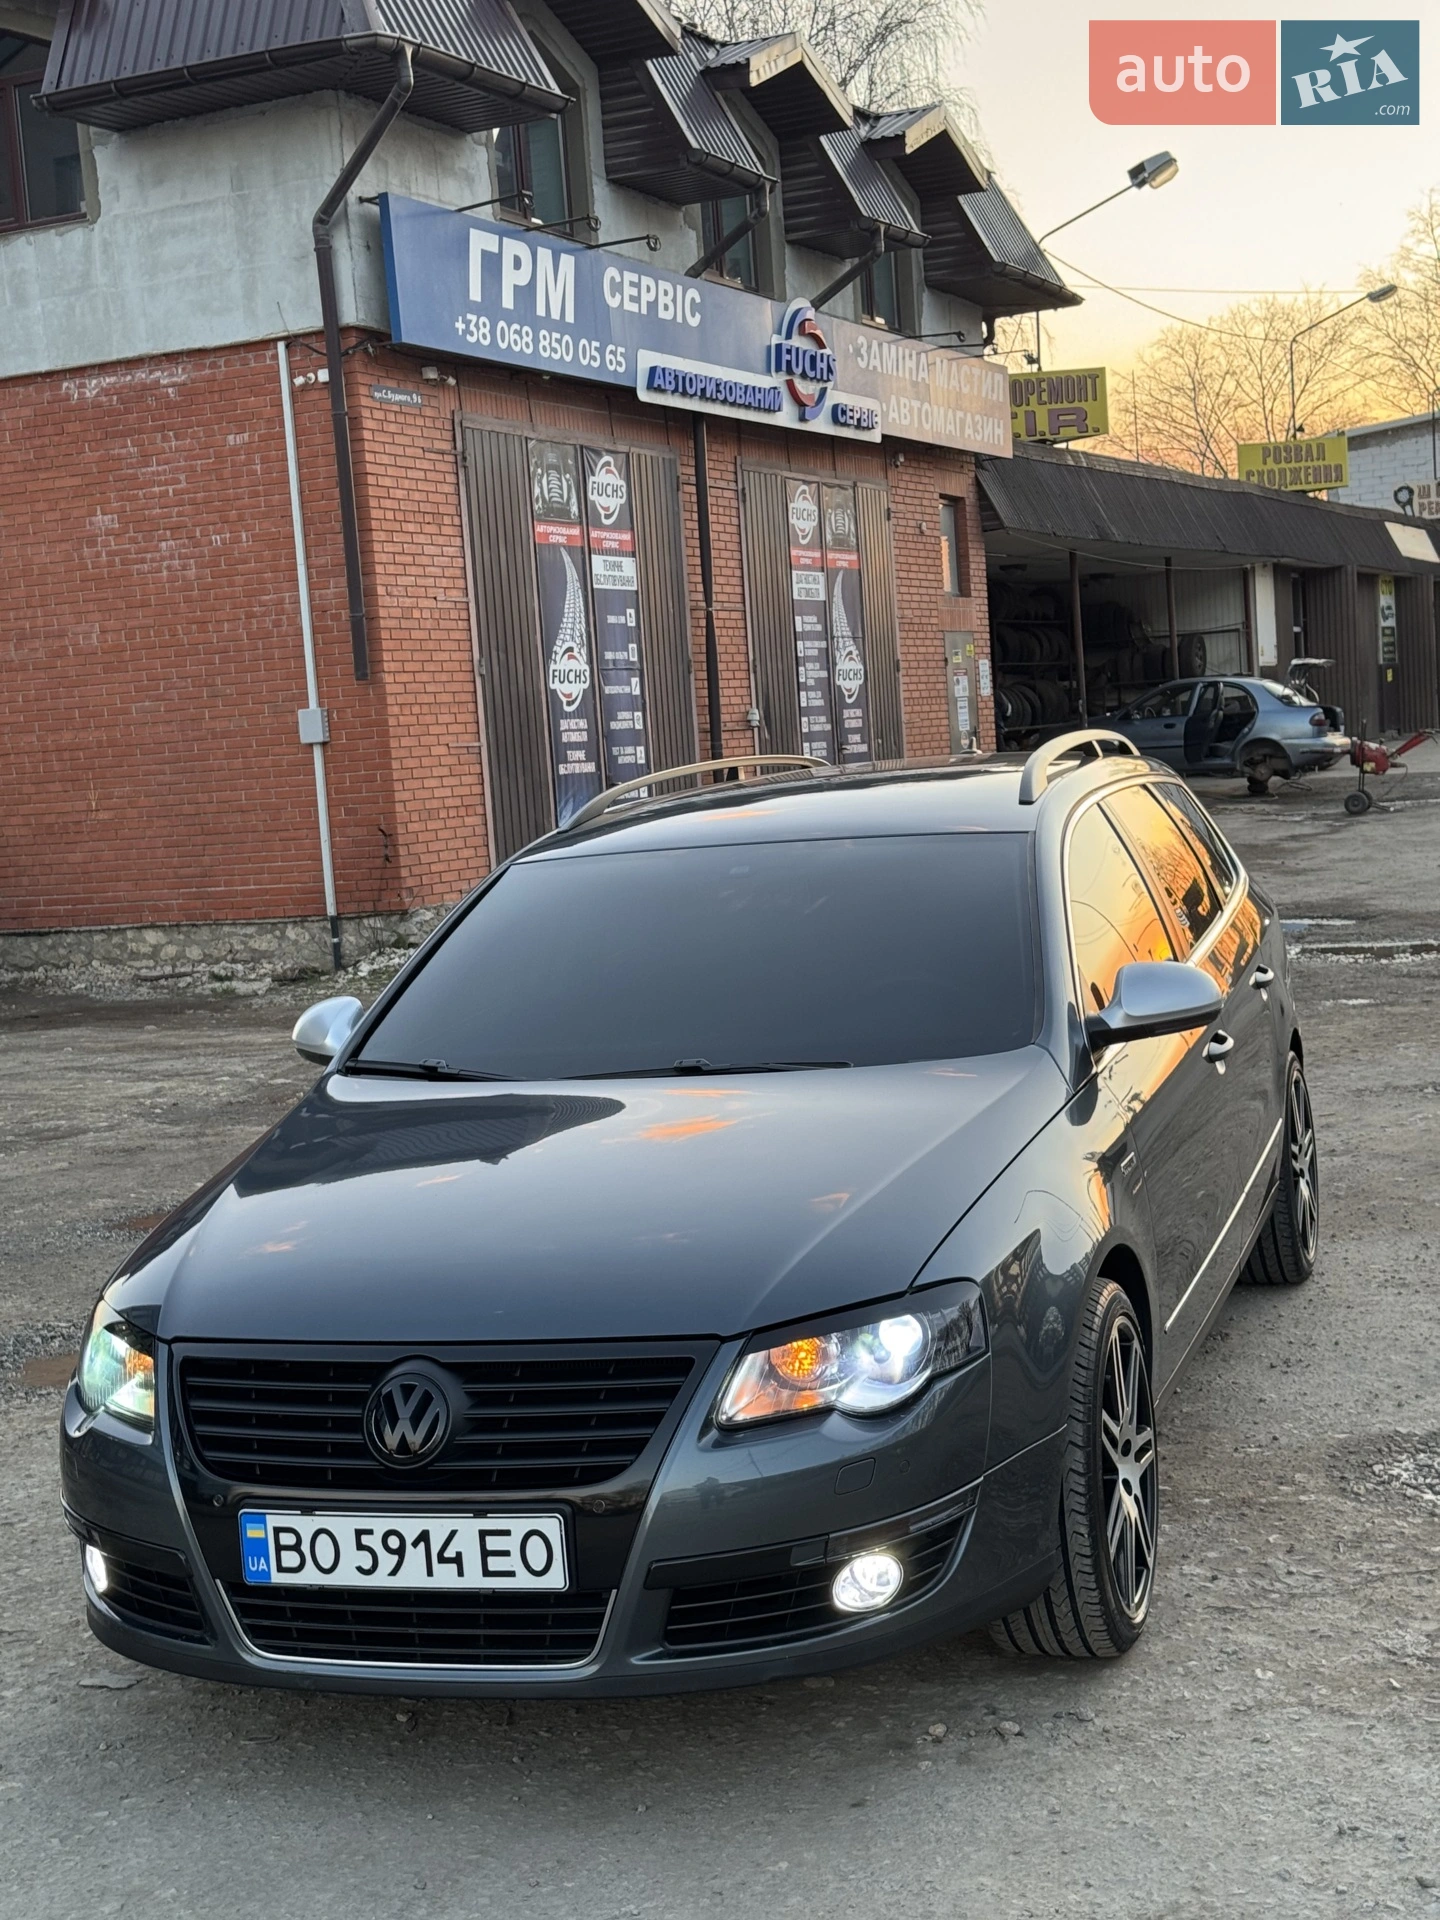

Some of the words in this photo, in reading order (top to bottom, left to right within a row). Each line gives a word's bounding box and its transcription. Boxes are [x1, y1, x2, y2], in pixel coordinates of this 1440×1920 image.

[468, 227, 575, 323] ГРМ
[603, 266, 701, 327] СЕРВІС
[455, 313, 491, 346] +38
[496, 321, 533, 355] 068
[539, 329, 573, 362] 850
[579, 338, 600, 368] 05
[605, 344, 626, 373] 65
[778, 343, 836, 383] FUCHS
[856, 335, 930, 384] ЗАМІНА
[935, 357, 1004, 402] МАСТИЛ
[650, 365, 784, 413] АВТОРИЗОВАНИЙ
[835, 402, 881, 431] СЕРВІС
[888, 394, 1004, 446] АВТОМАГАЗИН
[1262, 442, 1326, 465] РОЗВАЛ
[591, 481, 625, 500] FUCHS
[791, 506, 816, 522] FUCHS
[551, 669, 588, 684] FUCHS
[837, 668, 863, 681] FUCHS
[248, 1555, 269, 1573] UA
[273, 1526, 341, 1575] BO
[354, 1528, 465, 1578] 5914
[478, 1528, 554, 1578] EO
